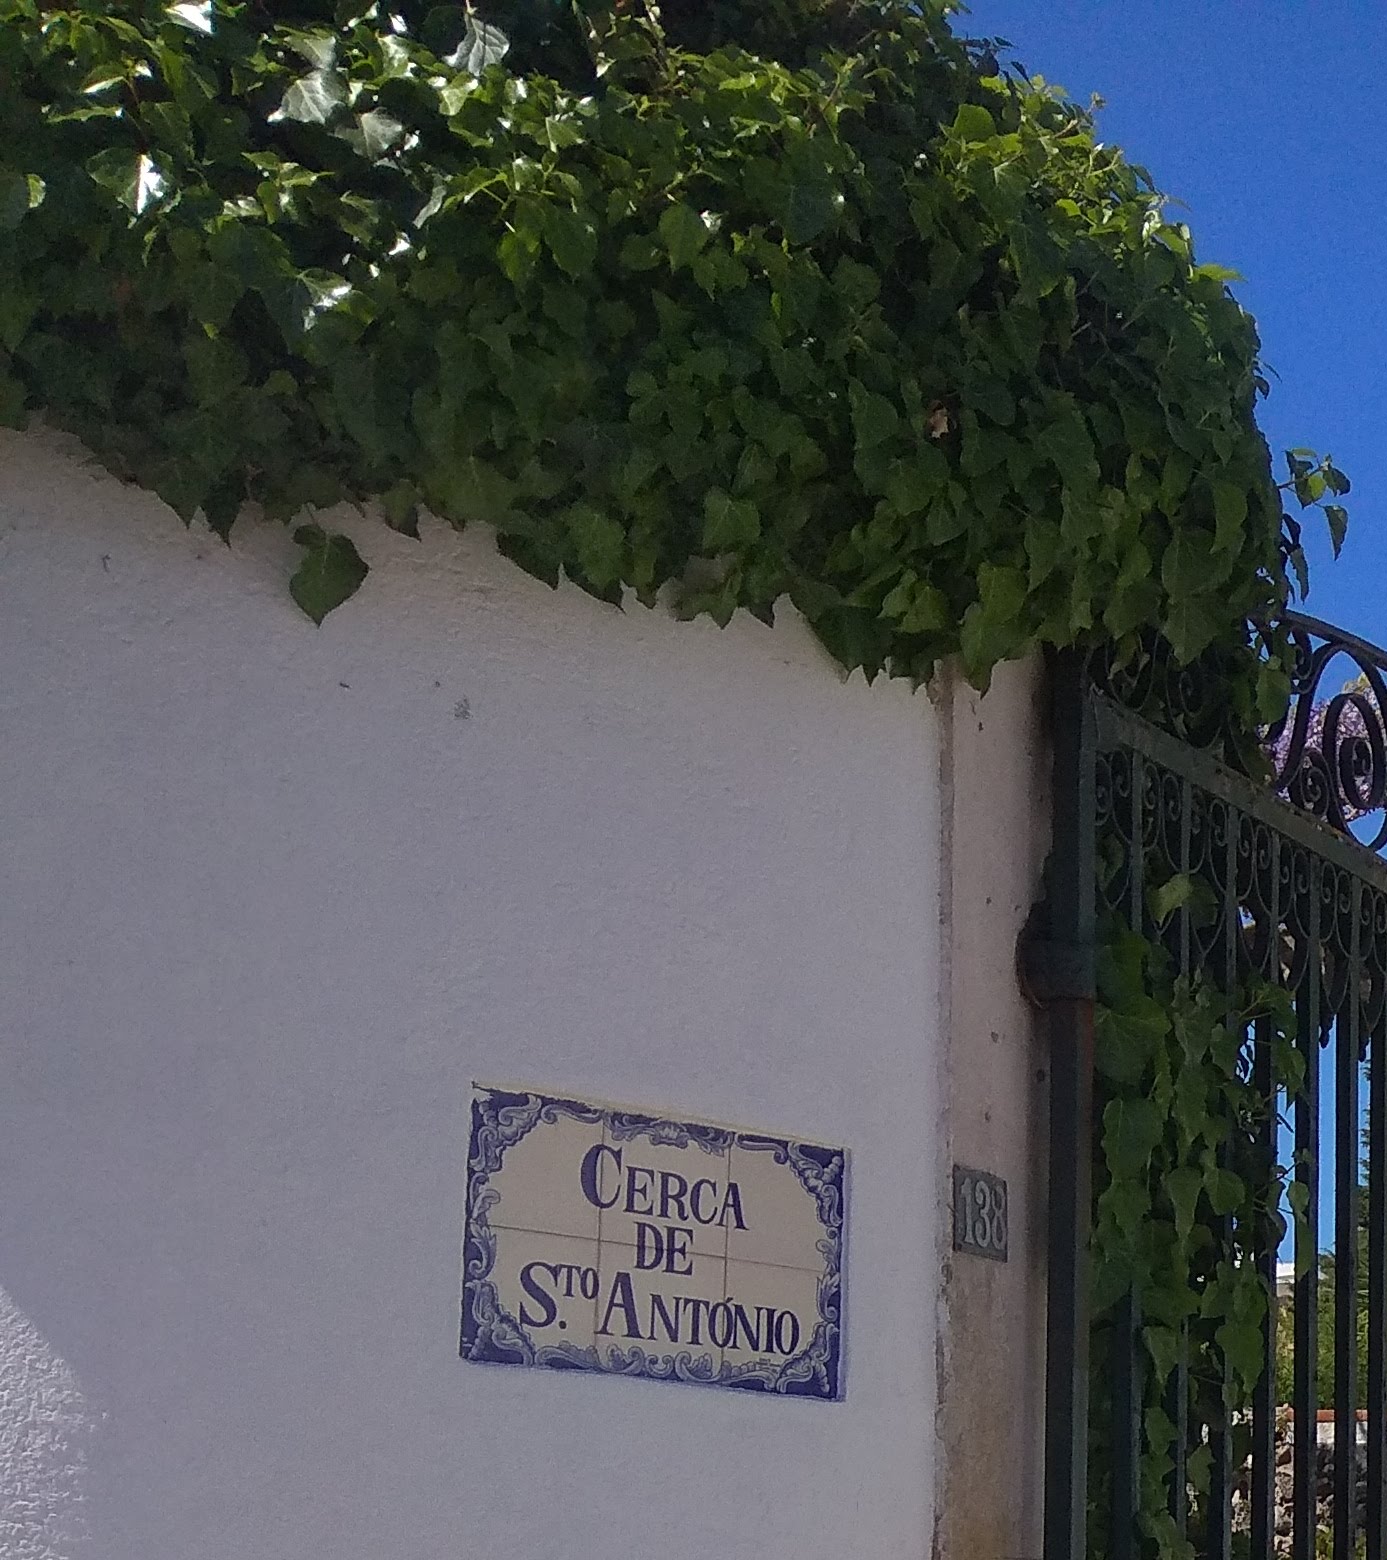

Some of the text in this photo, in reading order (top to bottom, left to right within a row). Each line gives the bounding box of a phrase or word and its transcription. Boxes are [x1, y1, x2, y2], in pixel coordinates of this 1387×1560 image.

[580, 1144, 750, 1231] CERCA
[961, 1178, 1006, 1251] 138
[633, 1221, 694, 1276] DE
[594, 1271, 799, 1356] ANTÓNIO
